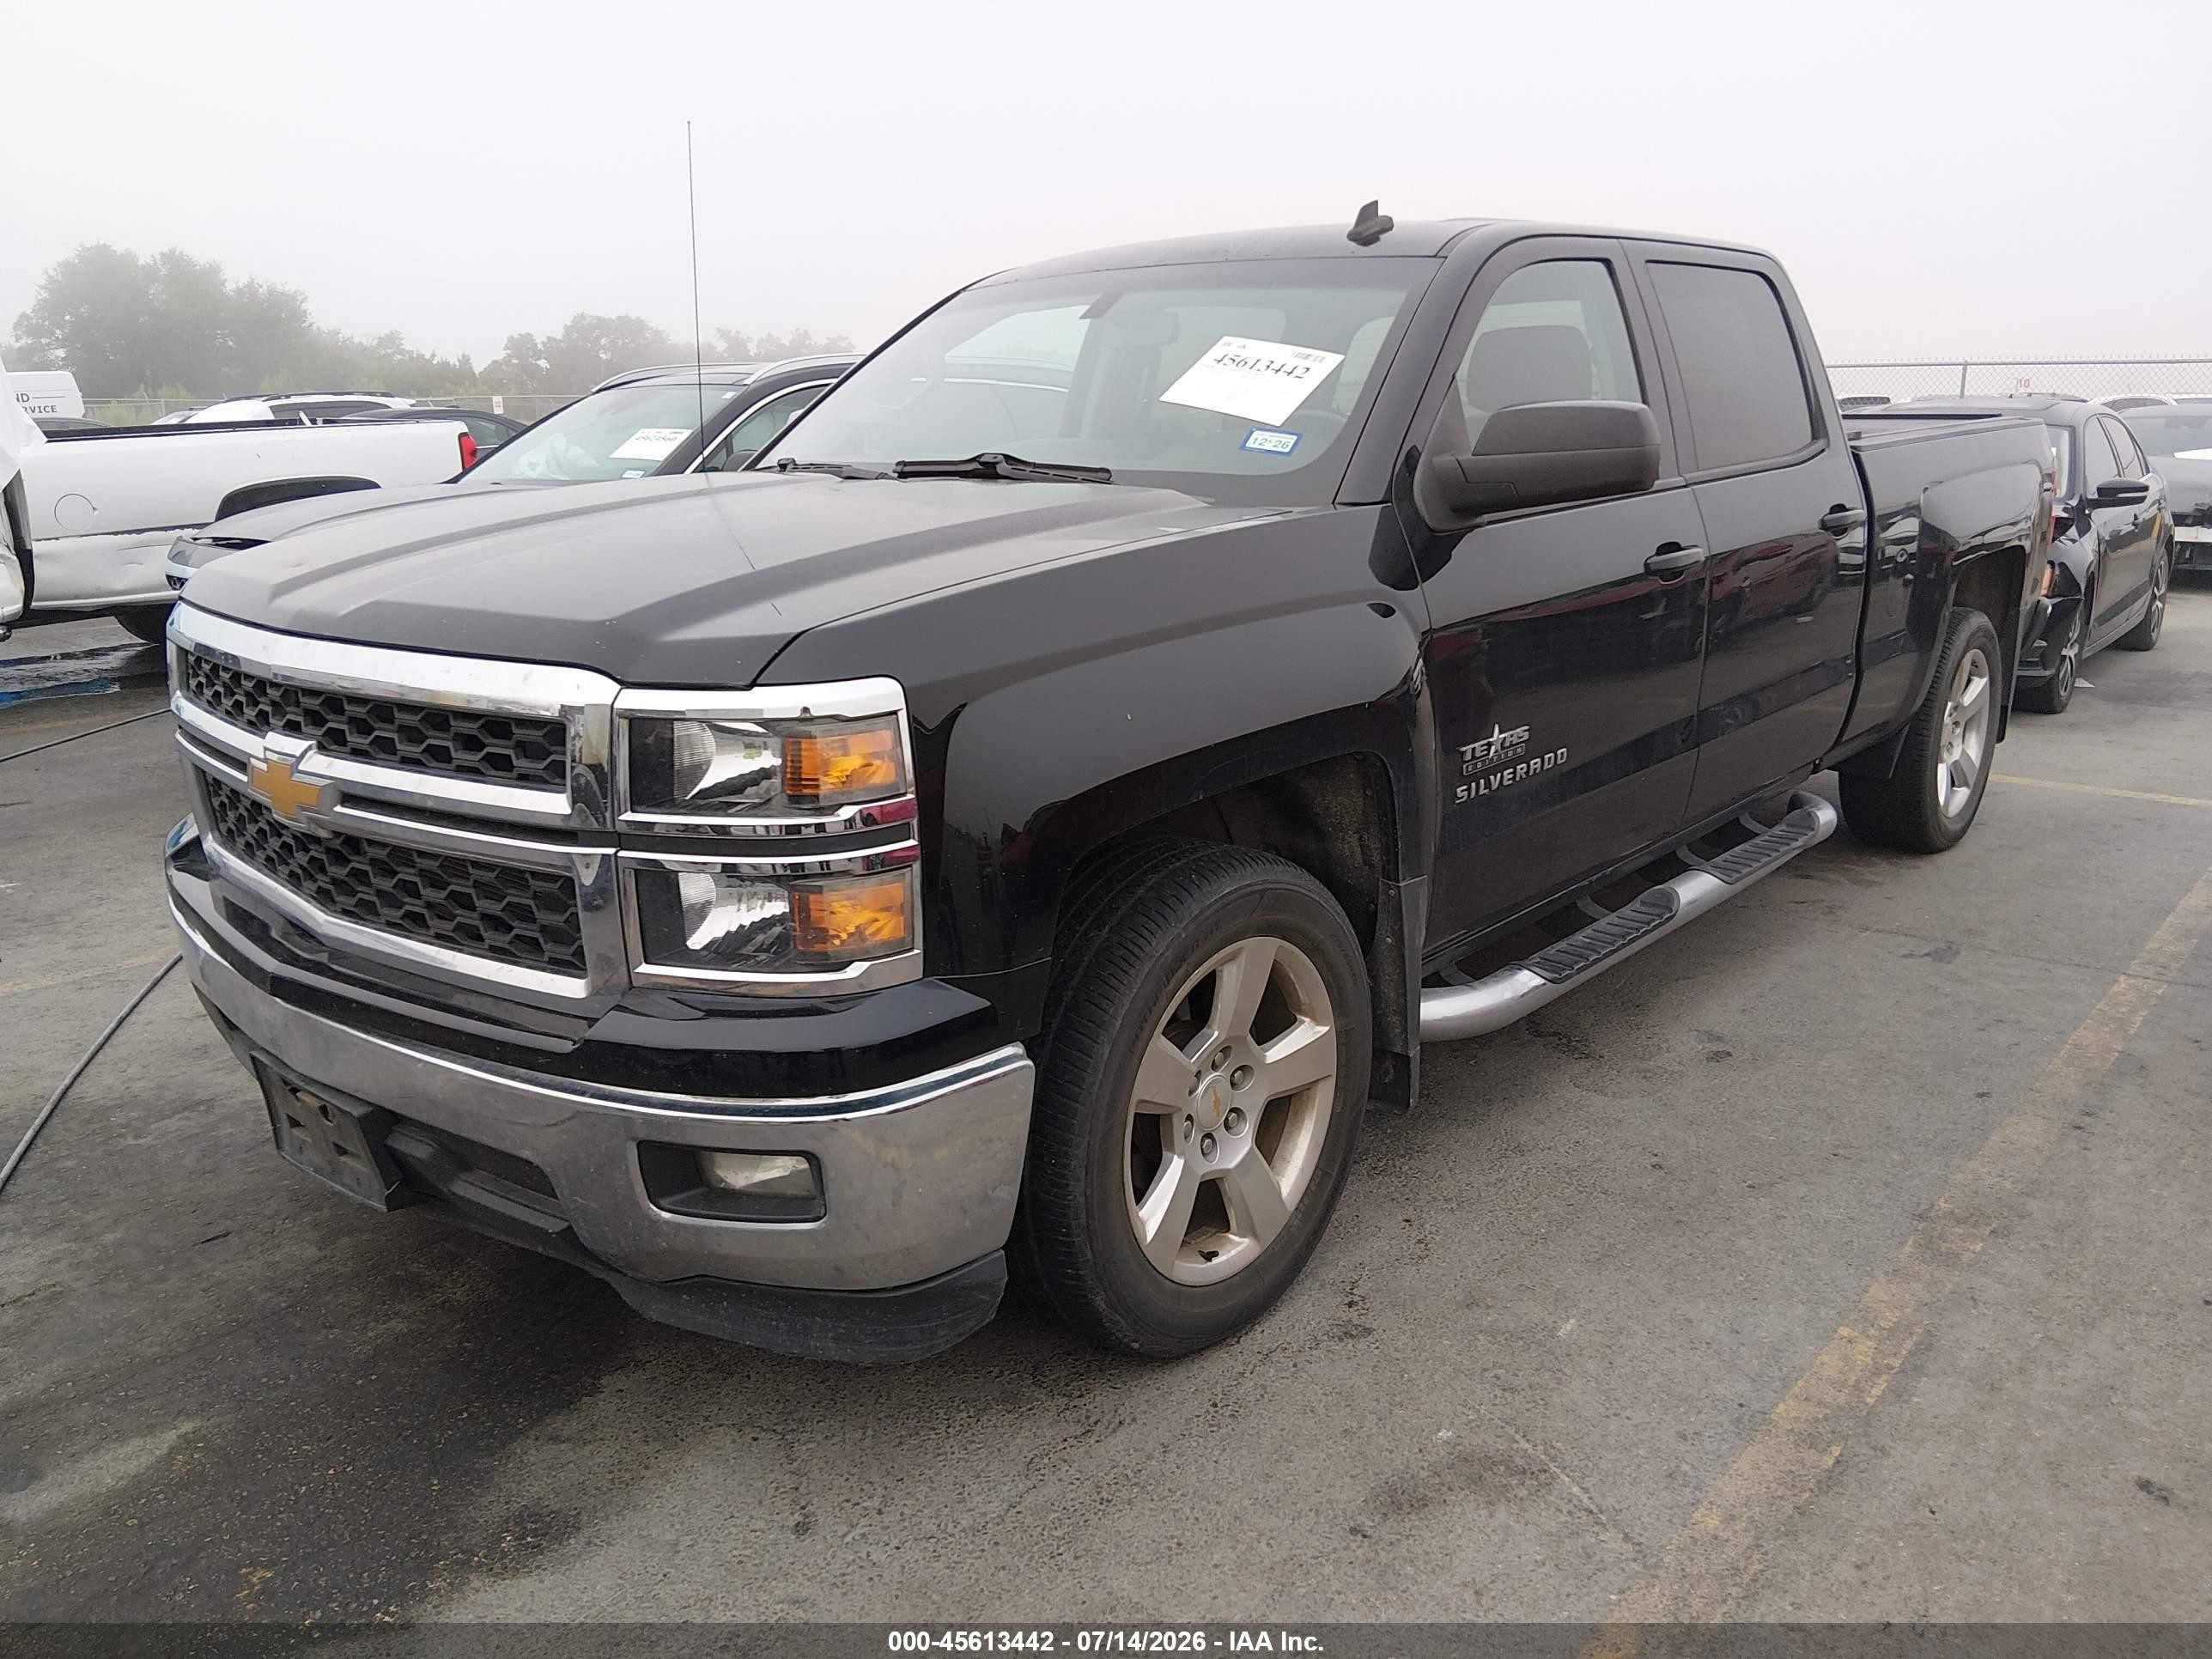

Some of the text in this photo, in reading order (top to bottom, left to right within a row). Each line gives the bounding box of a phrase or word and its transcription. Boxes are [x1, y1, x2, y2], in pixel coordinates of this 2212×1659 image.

[1213, 353, 1311, 380] 45613442
[1458, 723, 1530, 762] TEXAS
[1455, 747, 1568, 805] SILVERADO
